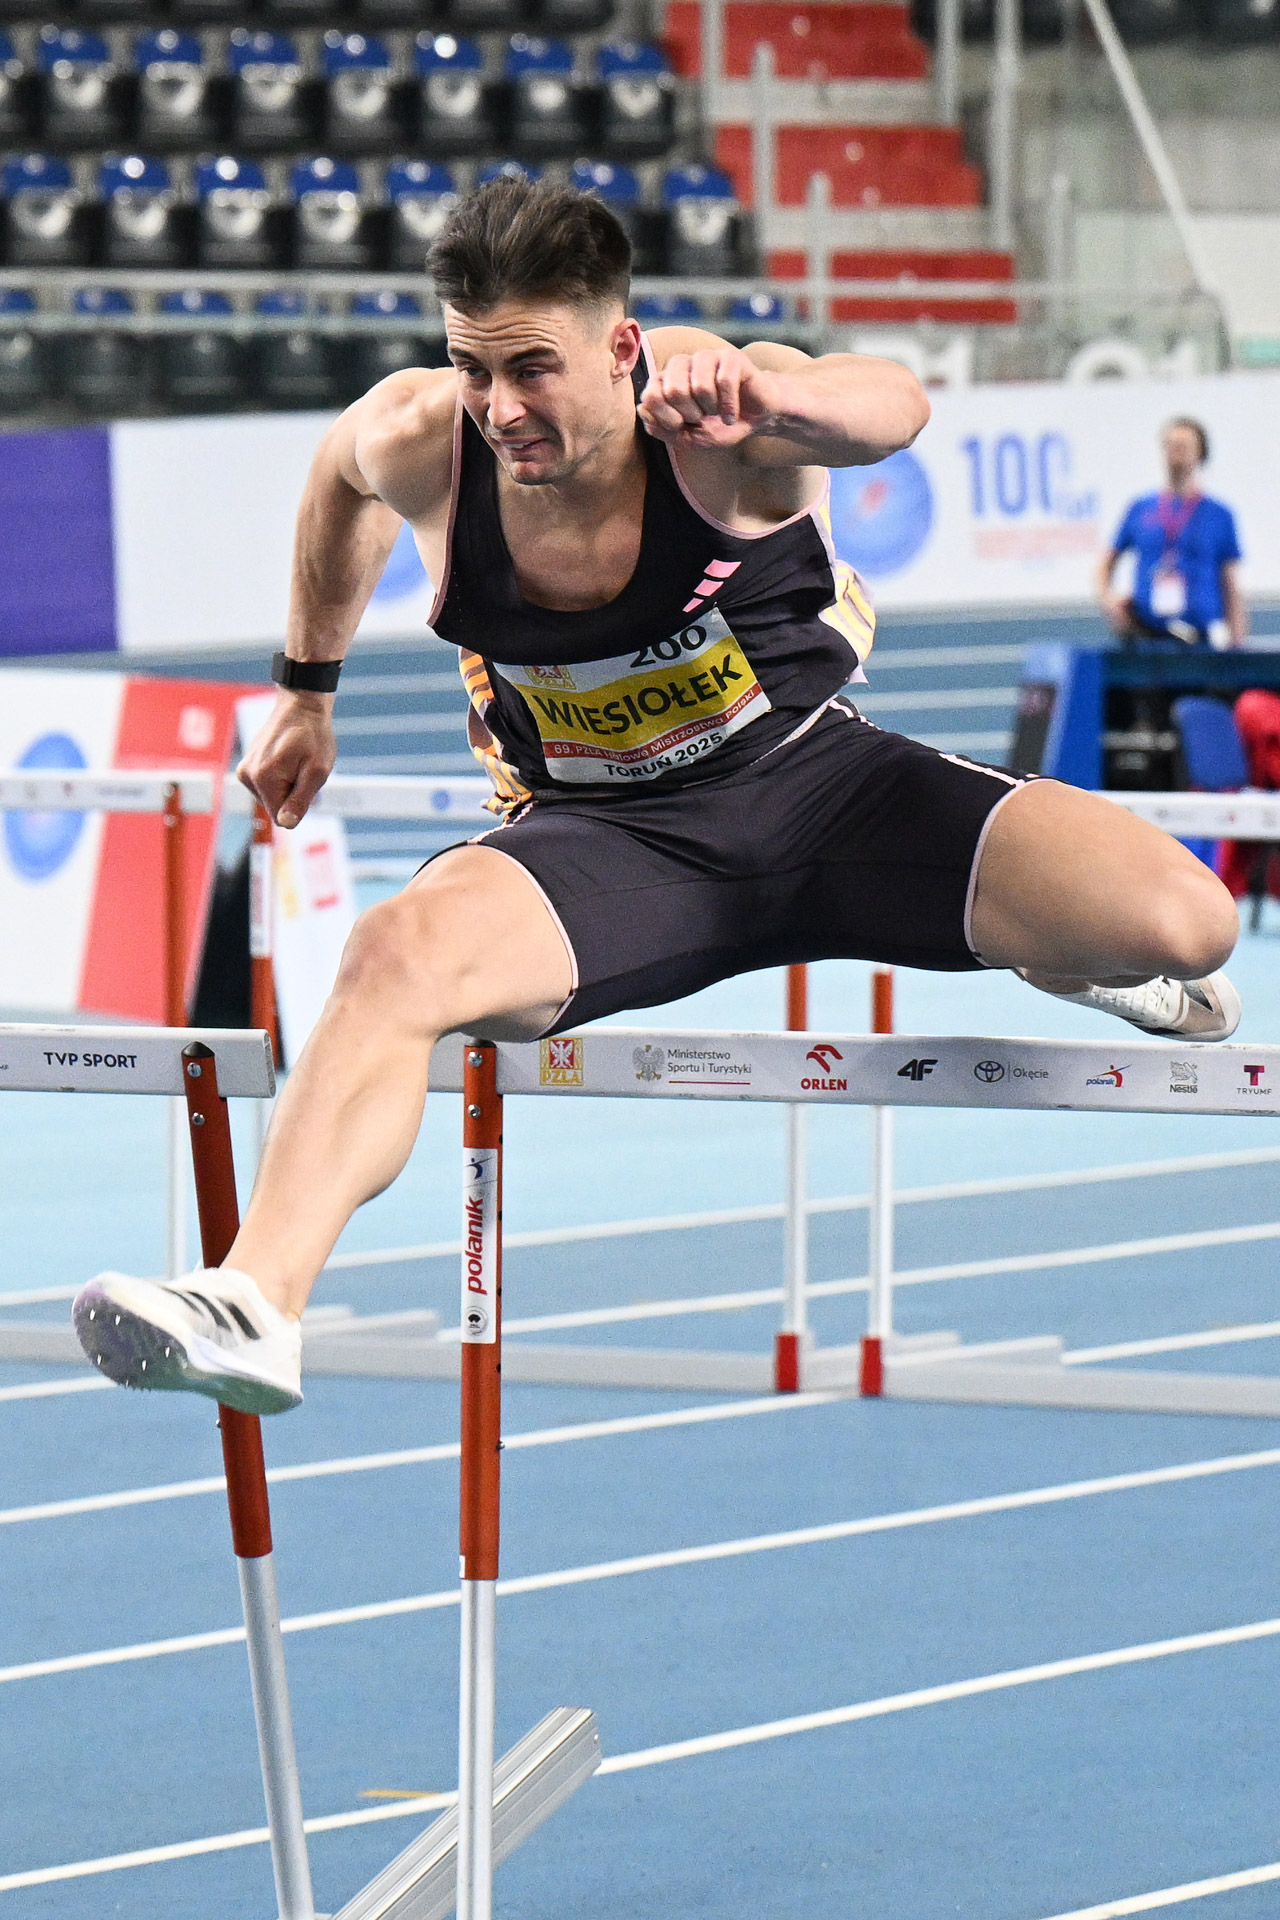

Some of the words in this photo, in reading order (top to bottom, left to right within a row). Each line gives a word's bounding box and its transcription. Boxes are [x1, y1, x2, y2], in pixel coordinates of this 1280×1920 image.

[630, 624, 707, 668] 200
[533, 654, 743, 735] WIESIOŁEK
[554, 744, 574, 754] 69.
[576, 745, 602, 757] PZLA
[651, 717, 724, 753] Mistrzostwa
[726, 689, 755, 720] Polski
[604, 754, 673, 777] TORUŃ
[675, 732, 723, 762] 2025
[43, 1051, 78, 1066] TVP
[84, 1054, 137, 1068] SPORT
[668, 1049, 731, 1060] Ministerstwo
[668, 1062, 699, 1074] Sportu
[702, 1062, 707, 1073] i
[709, 1063, 752, 1075] Turystyki
[897, 1059, 938, 1081] 4F
[1013, 1067, 1049, 1080] Okęcie
[801, 1078, 847, 1091] ORLEN
[1086, 1078, 1115, 1086] polanik
[1237, 1087, 1272, 1095] TRYUMF
[465, 1195, 488, 1296] polanik
